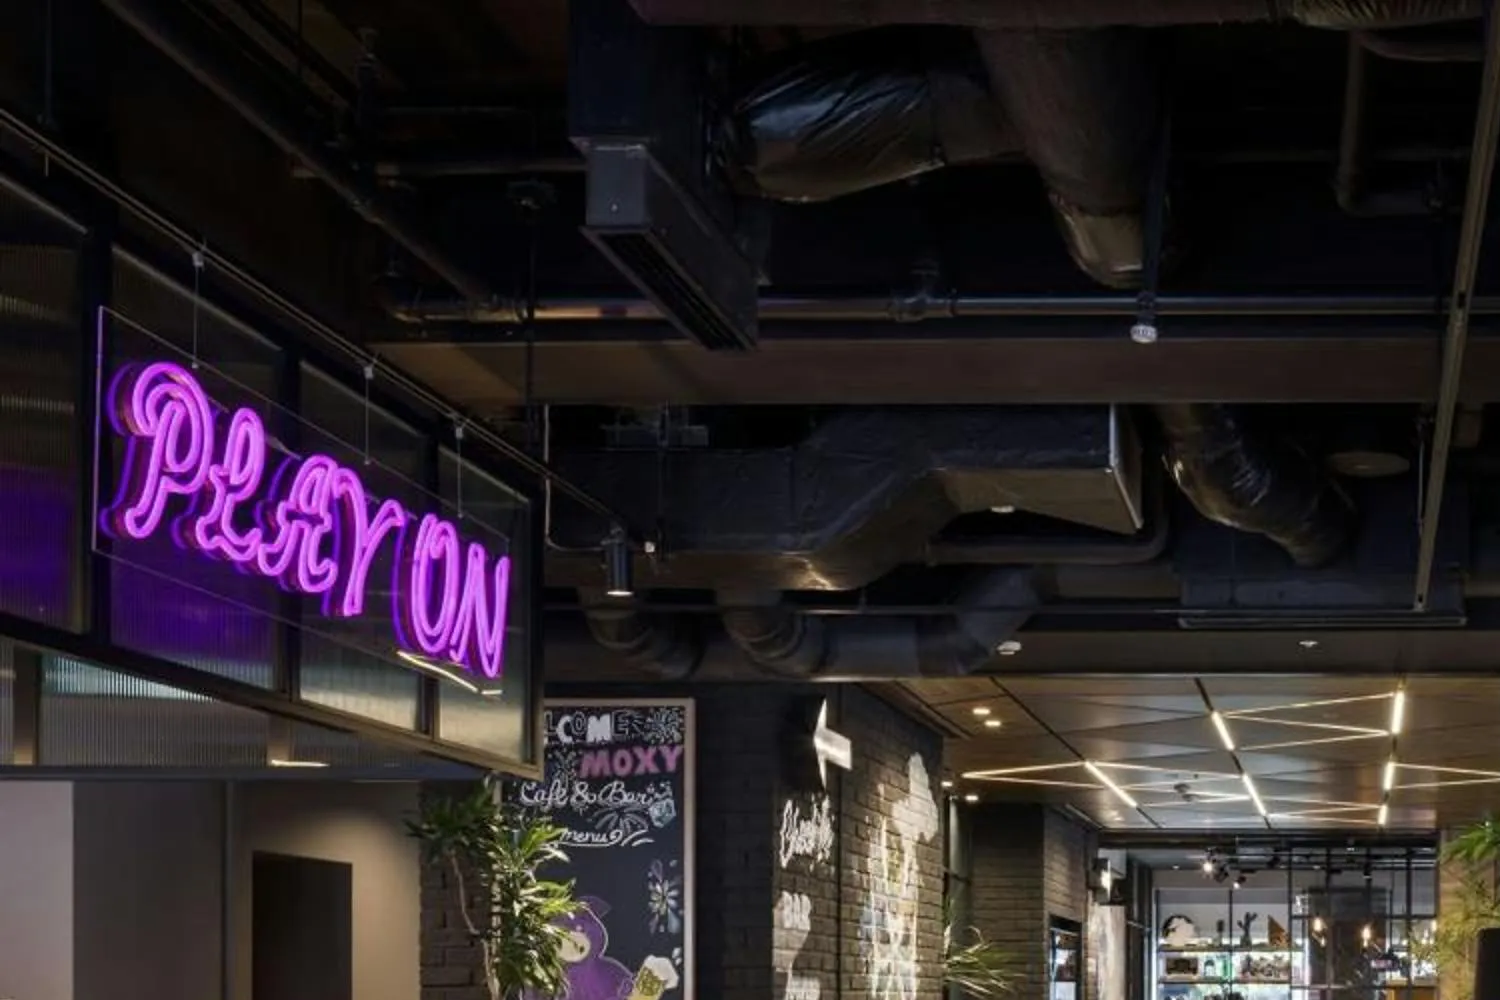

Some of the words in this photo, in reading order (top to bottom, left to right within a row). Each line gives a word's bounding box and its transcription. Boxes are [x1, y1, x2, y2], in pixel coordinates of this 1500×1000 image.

[122, 360, 407, 617] PLAY
[410, 513, 511, 679] ON
[578, 744, 684, 779] MOXY
